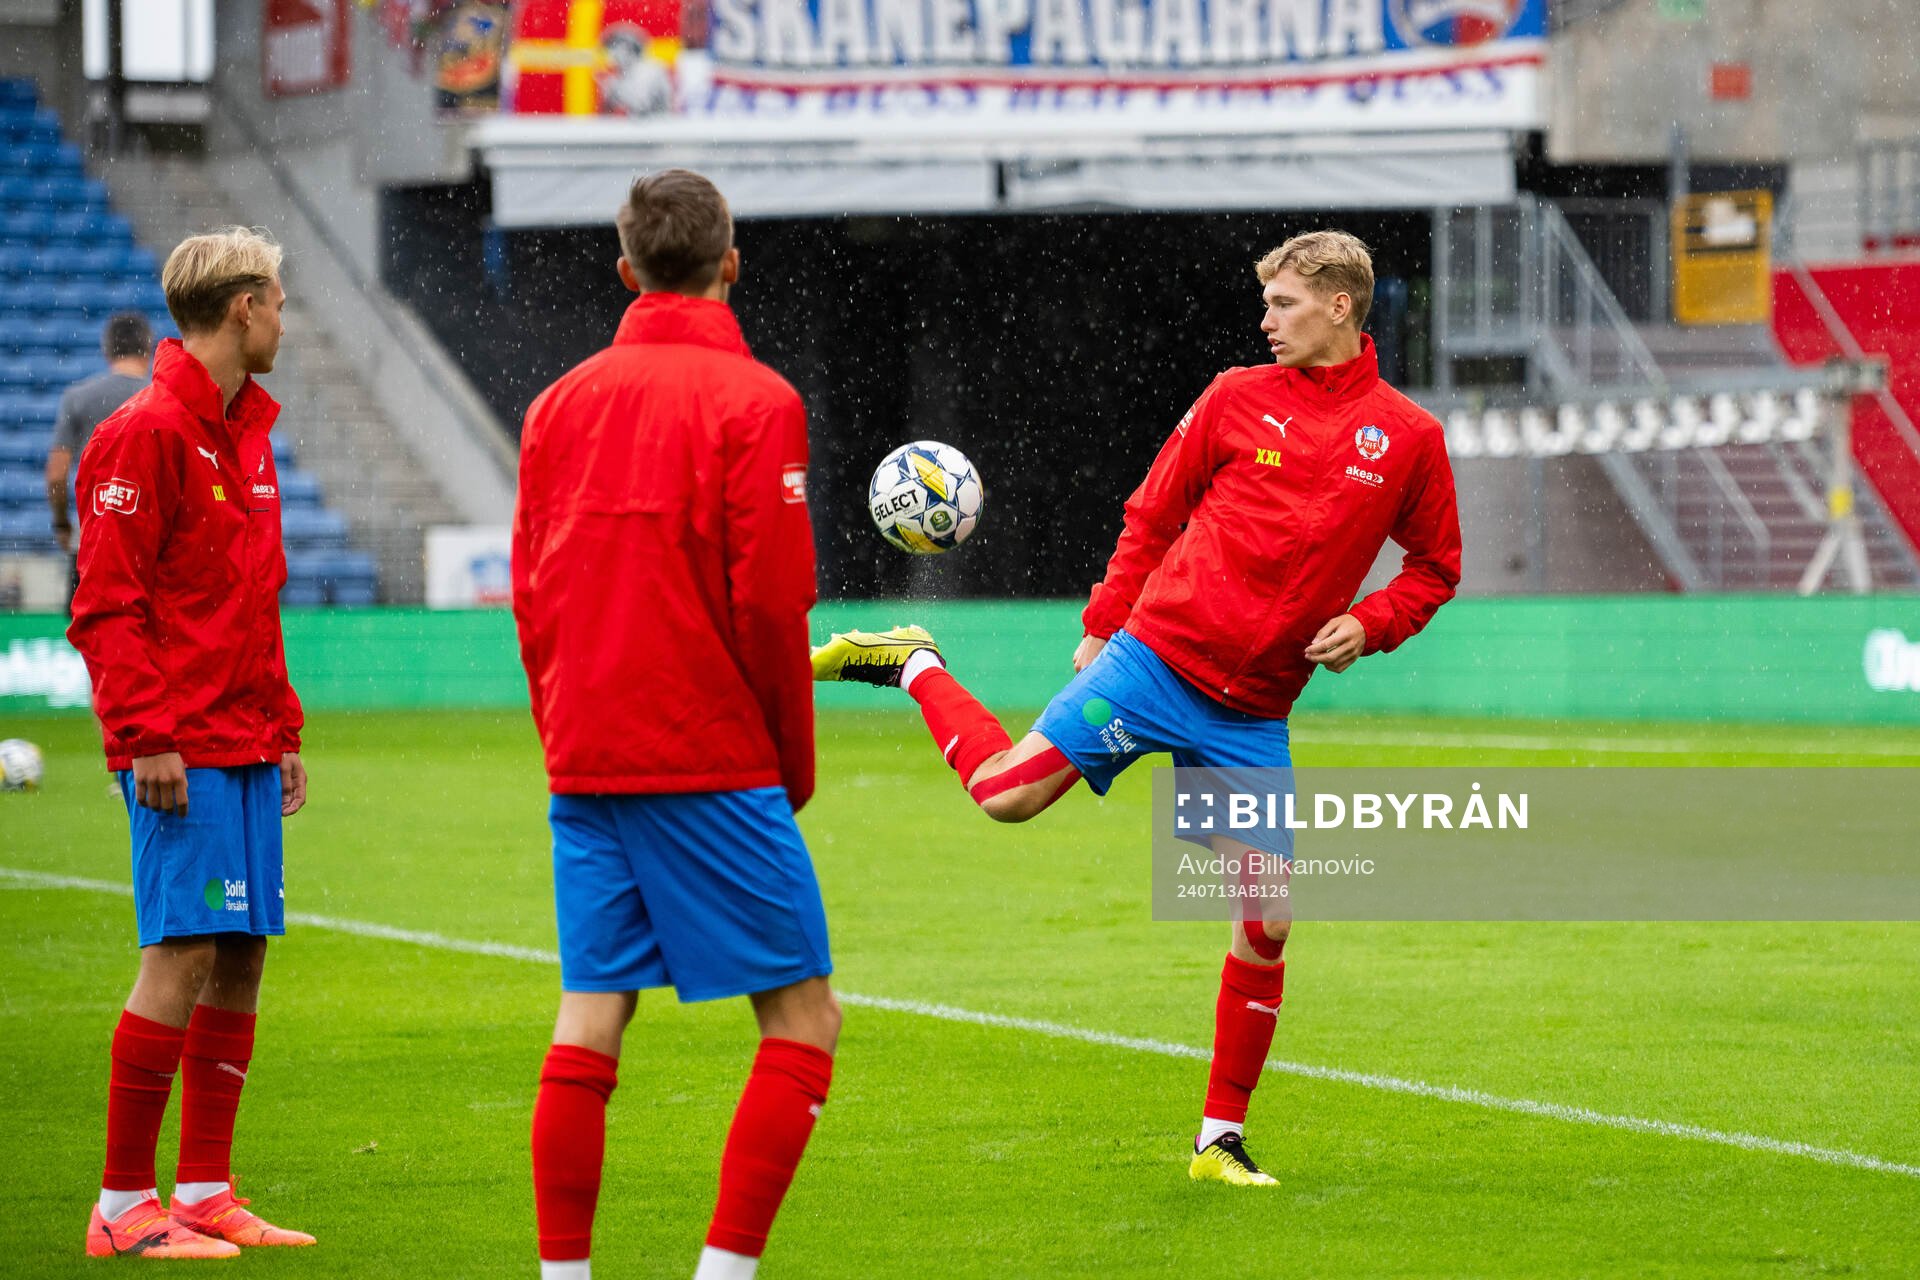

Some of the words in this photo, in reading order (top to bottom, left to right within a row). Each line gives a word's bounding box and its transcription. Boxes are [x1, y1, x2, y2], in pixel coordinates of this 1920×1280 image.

[1255, 448, 1282, 467] XXL
[1345, 465, 1373, 481] akea
[874, 489, 918, 522] SELECT
[1108, 717, 1137, 754] Solid
[225, 879, 246, 898] Solid
